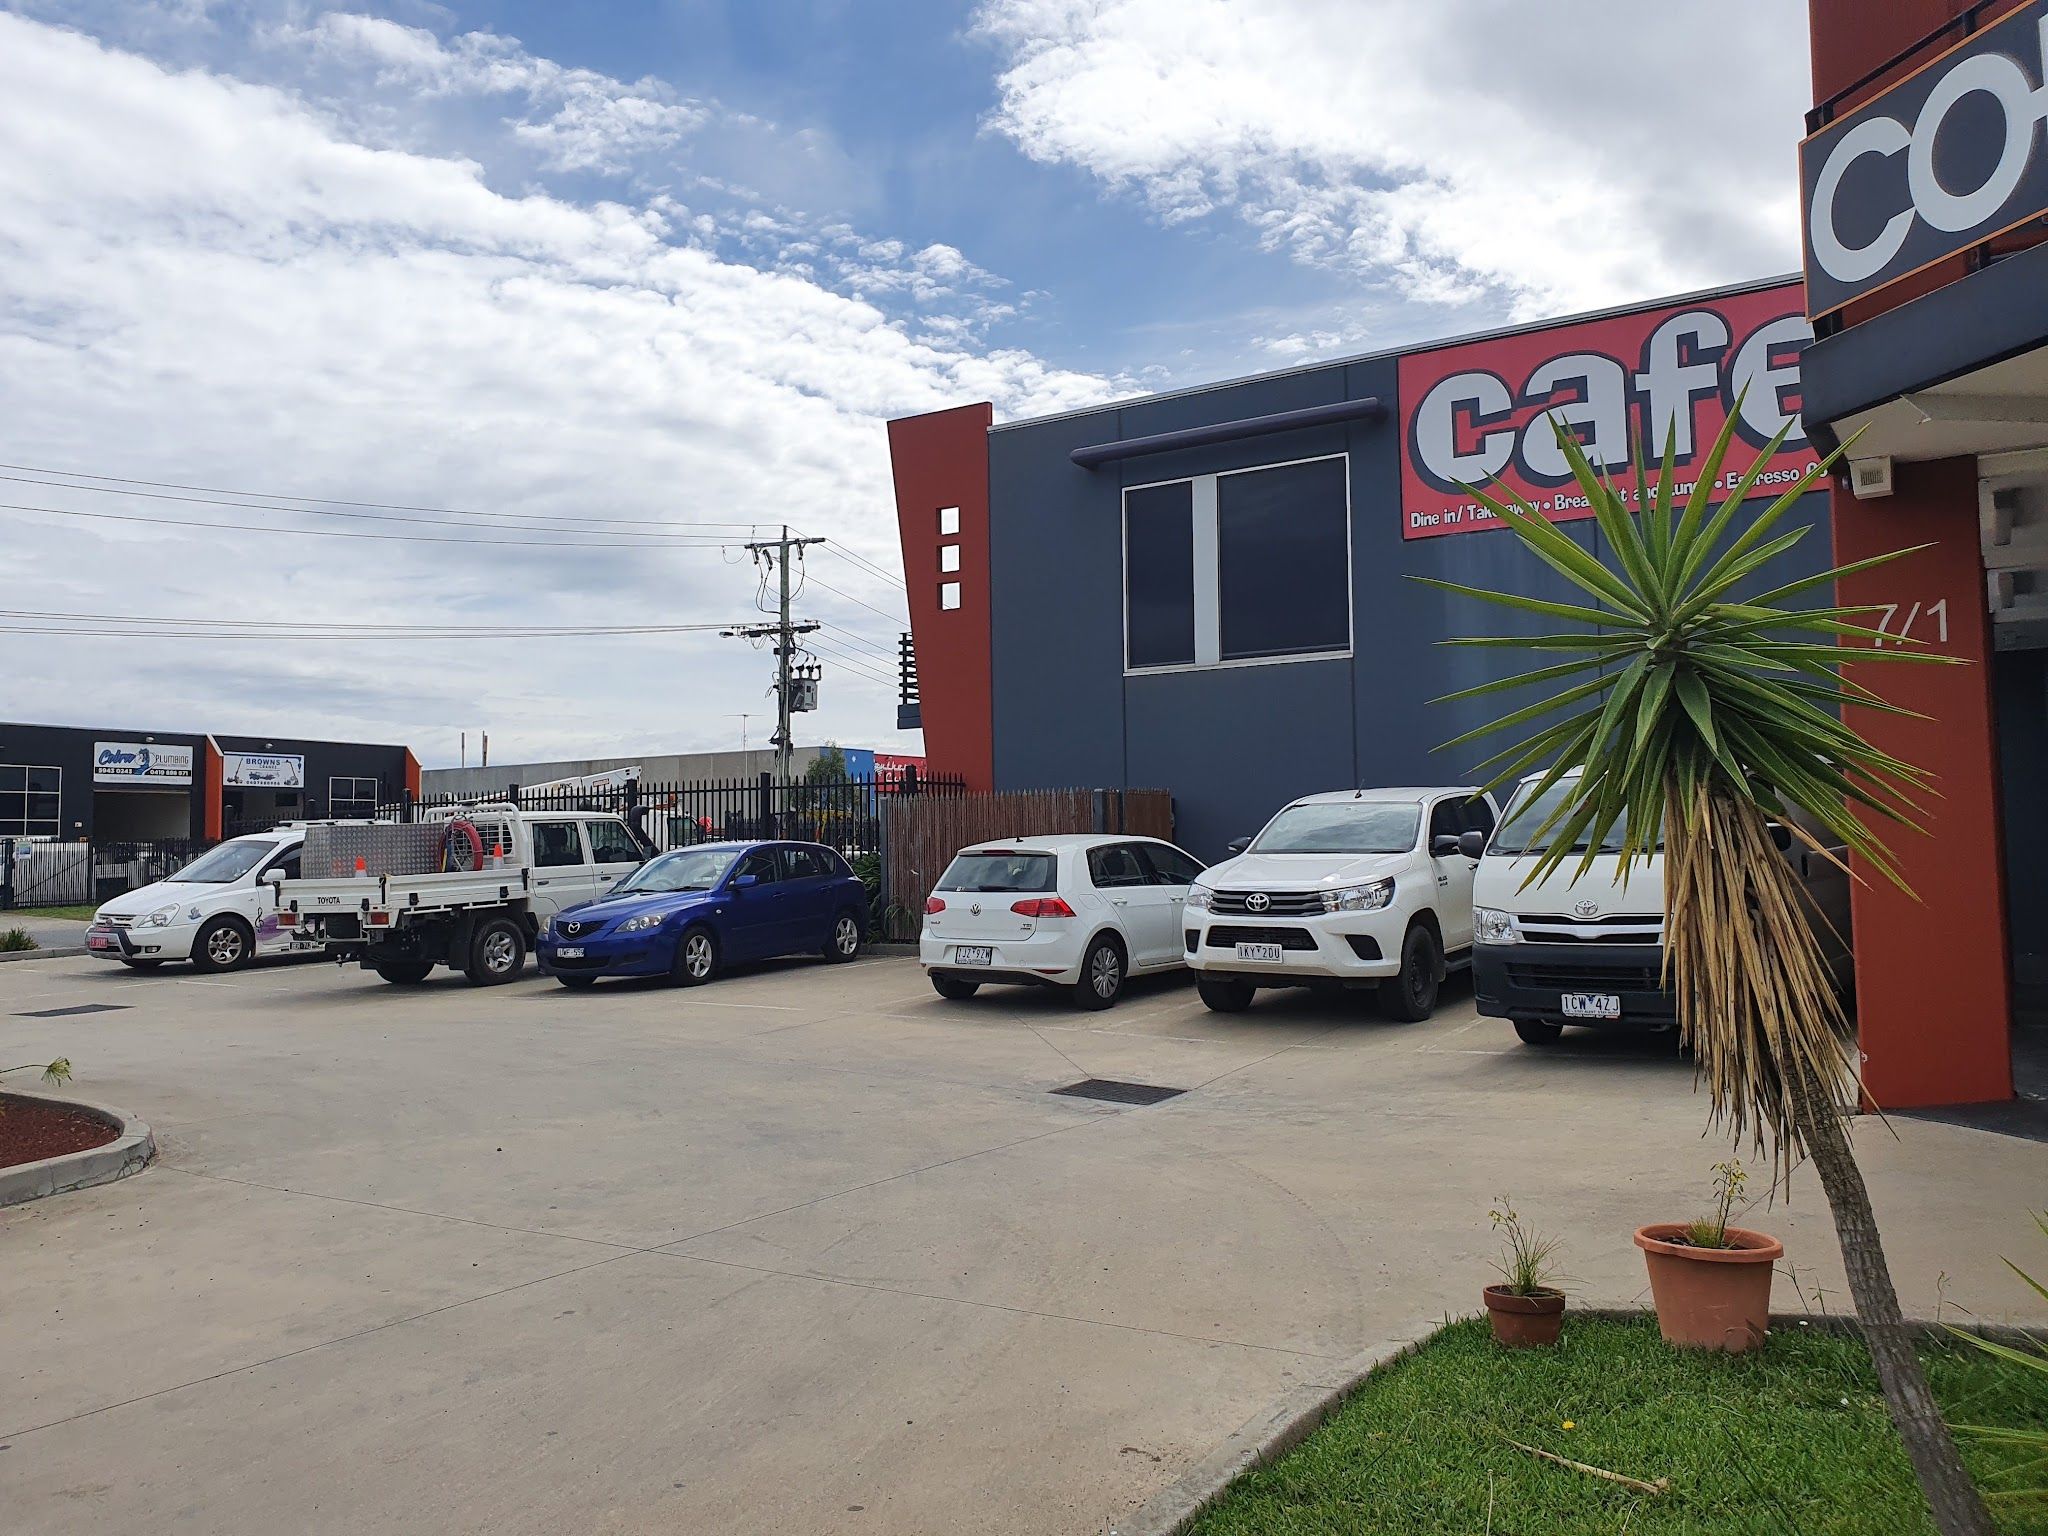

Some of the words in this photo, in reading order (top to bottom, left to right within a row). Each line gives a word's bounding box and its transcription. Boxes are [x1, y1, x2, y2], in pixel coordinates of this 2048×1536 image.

[1410, 511, 1440, 528] Dine
[1443, 505, 1464, 524] in/
[1725, 469, 1800, 490] Esresso
[1874, 598, 1948, 648] 7/1
[98, 748, 137, 765] Cobra
[245, 758, 281, 766] BROWNS
[317, 896, 341, 905] TOYOTA
[1564, 996, 1586, 1010] 1CW
[1595, 997, 1619, 1011] 4ZJ
